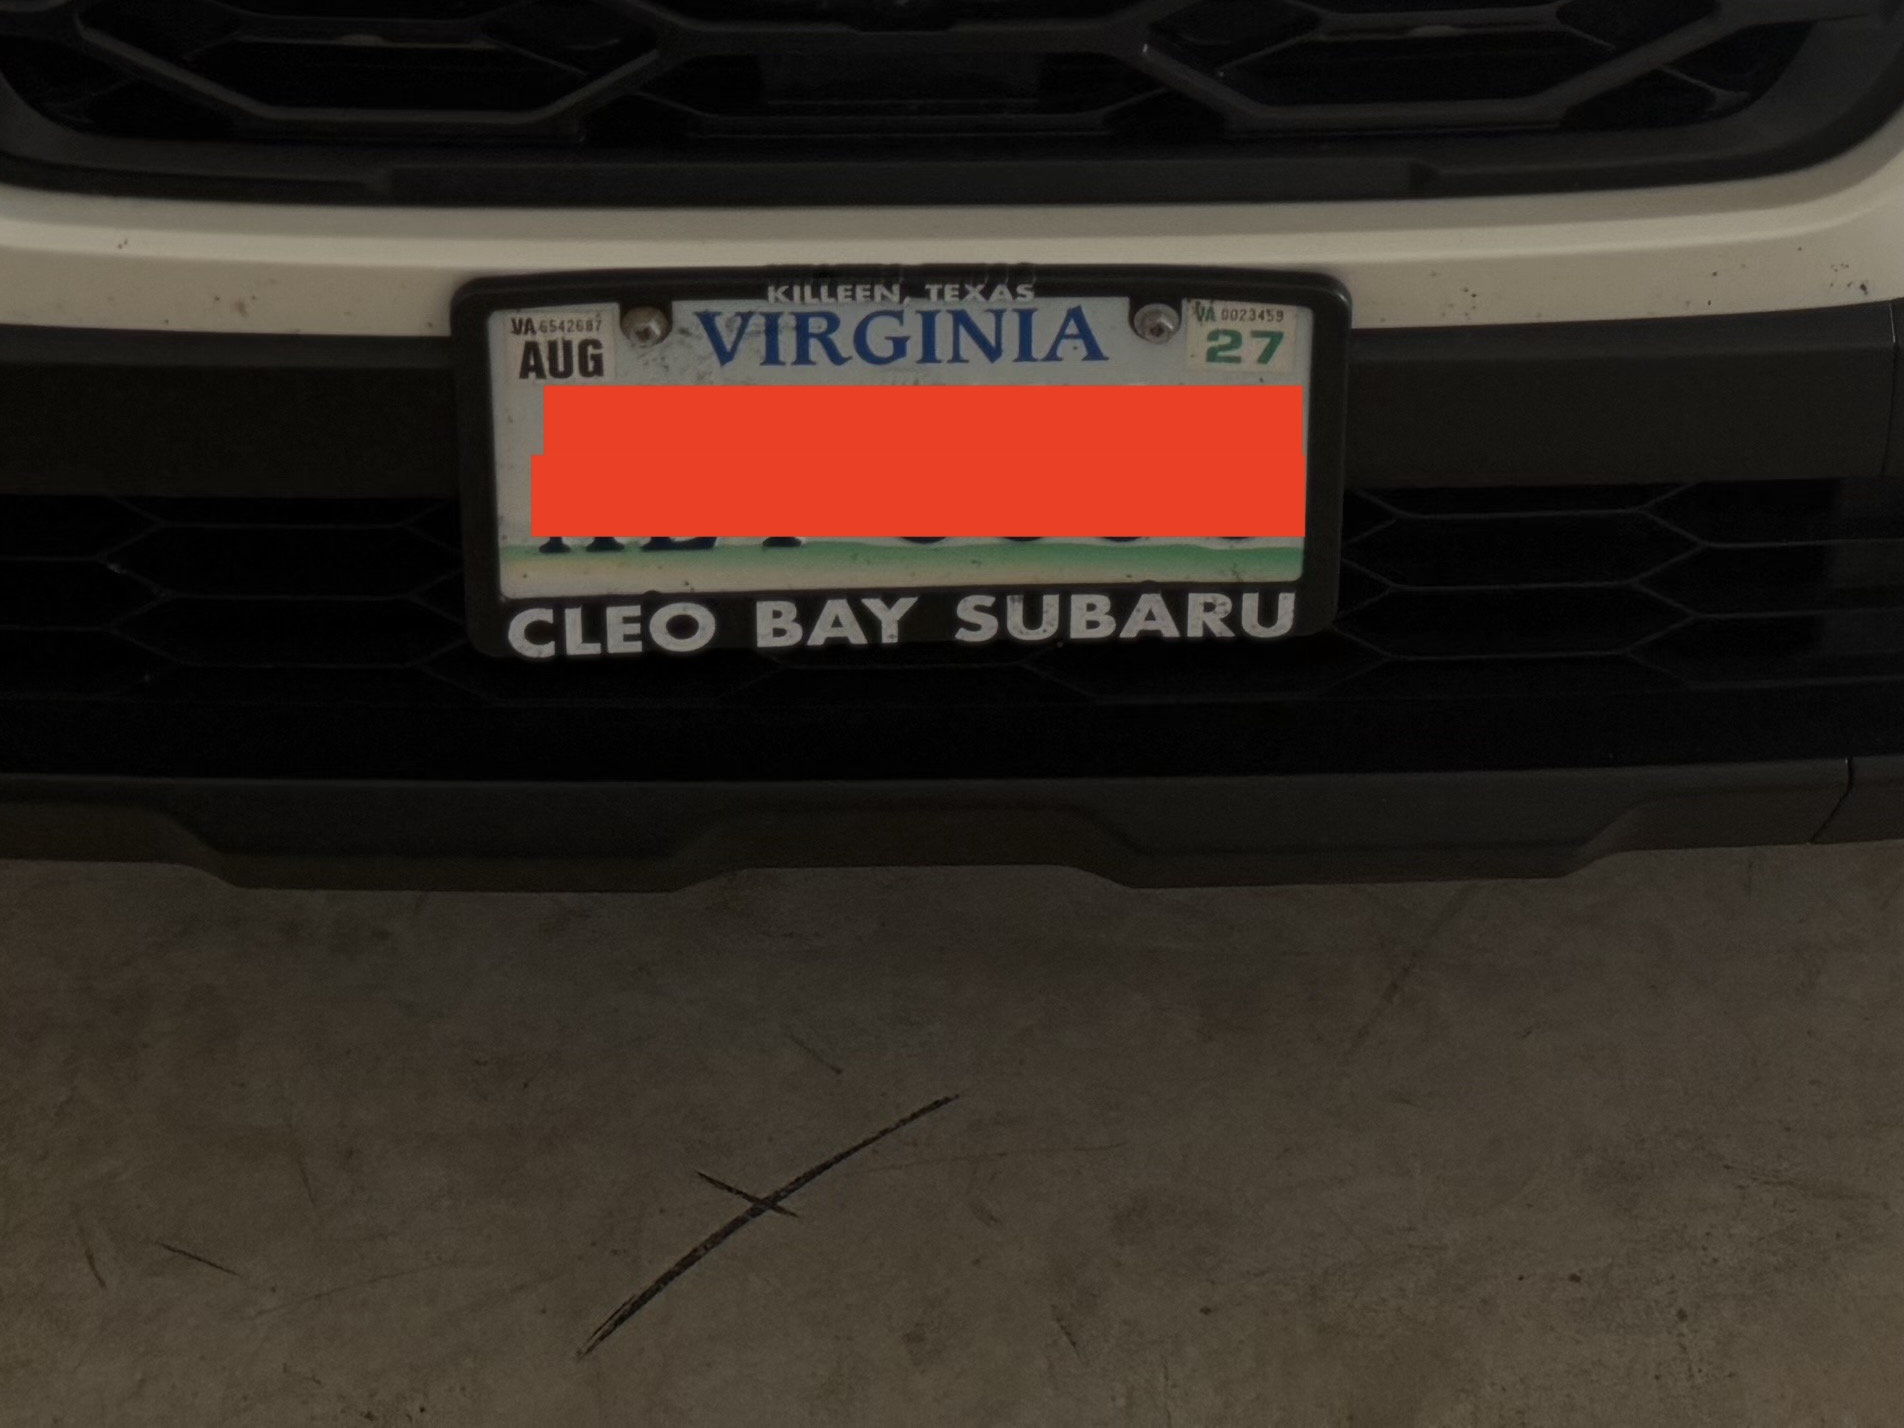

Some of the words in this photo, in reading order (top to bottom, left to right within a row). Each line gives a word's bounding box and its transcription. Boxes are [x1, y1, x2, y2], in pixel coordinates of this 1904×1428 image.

[767, 284, 910, 309] KILLEEN,
[925, 283, 1035, 302] TEXAS
[1196, 305, 1216, 322] VA
[510, 317, 536, 335] VA
[694, 305, 1109, 367] VIRGINIA
[519, 338, 604, 379] AUG
[1206, 329, 1284, 364] 27
[507, 601, 716, 658] CLEO
[756, 595, 919, 648] BAY
[953, 590, 1296, 644] SUBARU
